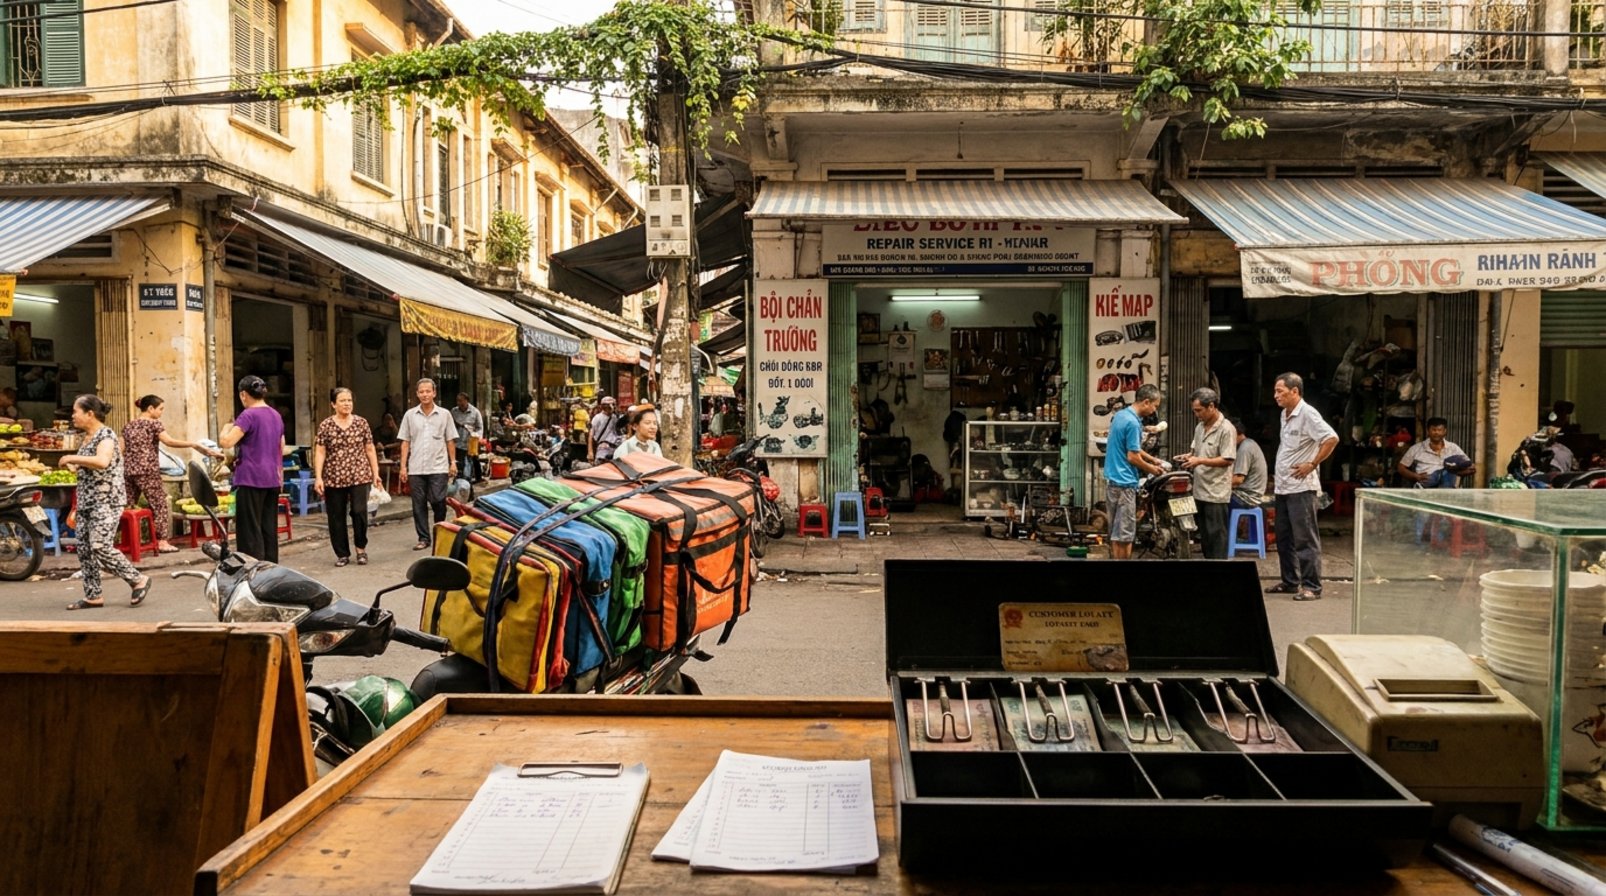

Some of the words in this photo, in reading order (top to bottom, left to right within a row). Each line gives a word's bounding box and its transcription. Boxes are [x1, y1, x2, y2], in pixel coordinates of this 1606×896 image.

[866, 237, 915, 249] REPAIR
[919, 237, 975, 249] SERVICE
[1122, 294, 1154, 317] MAP
